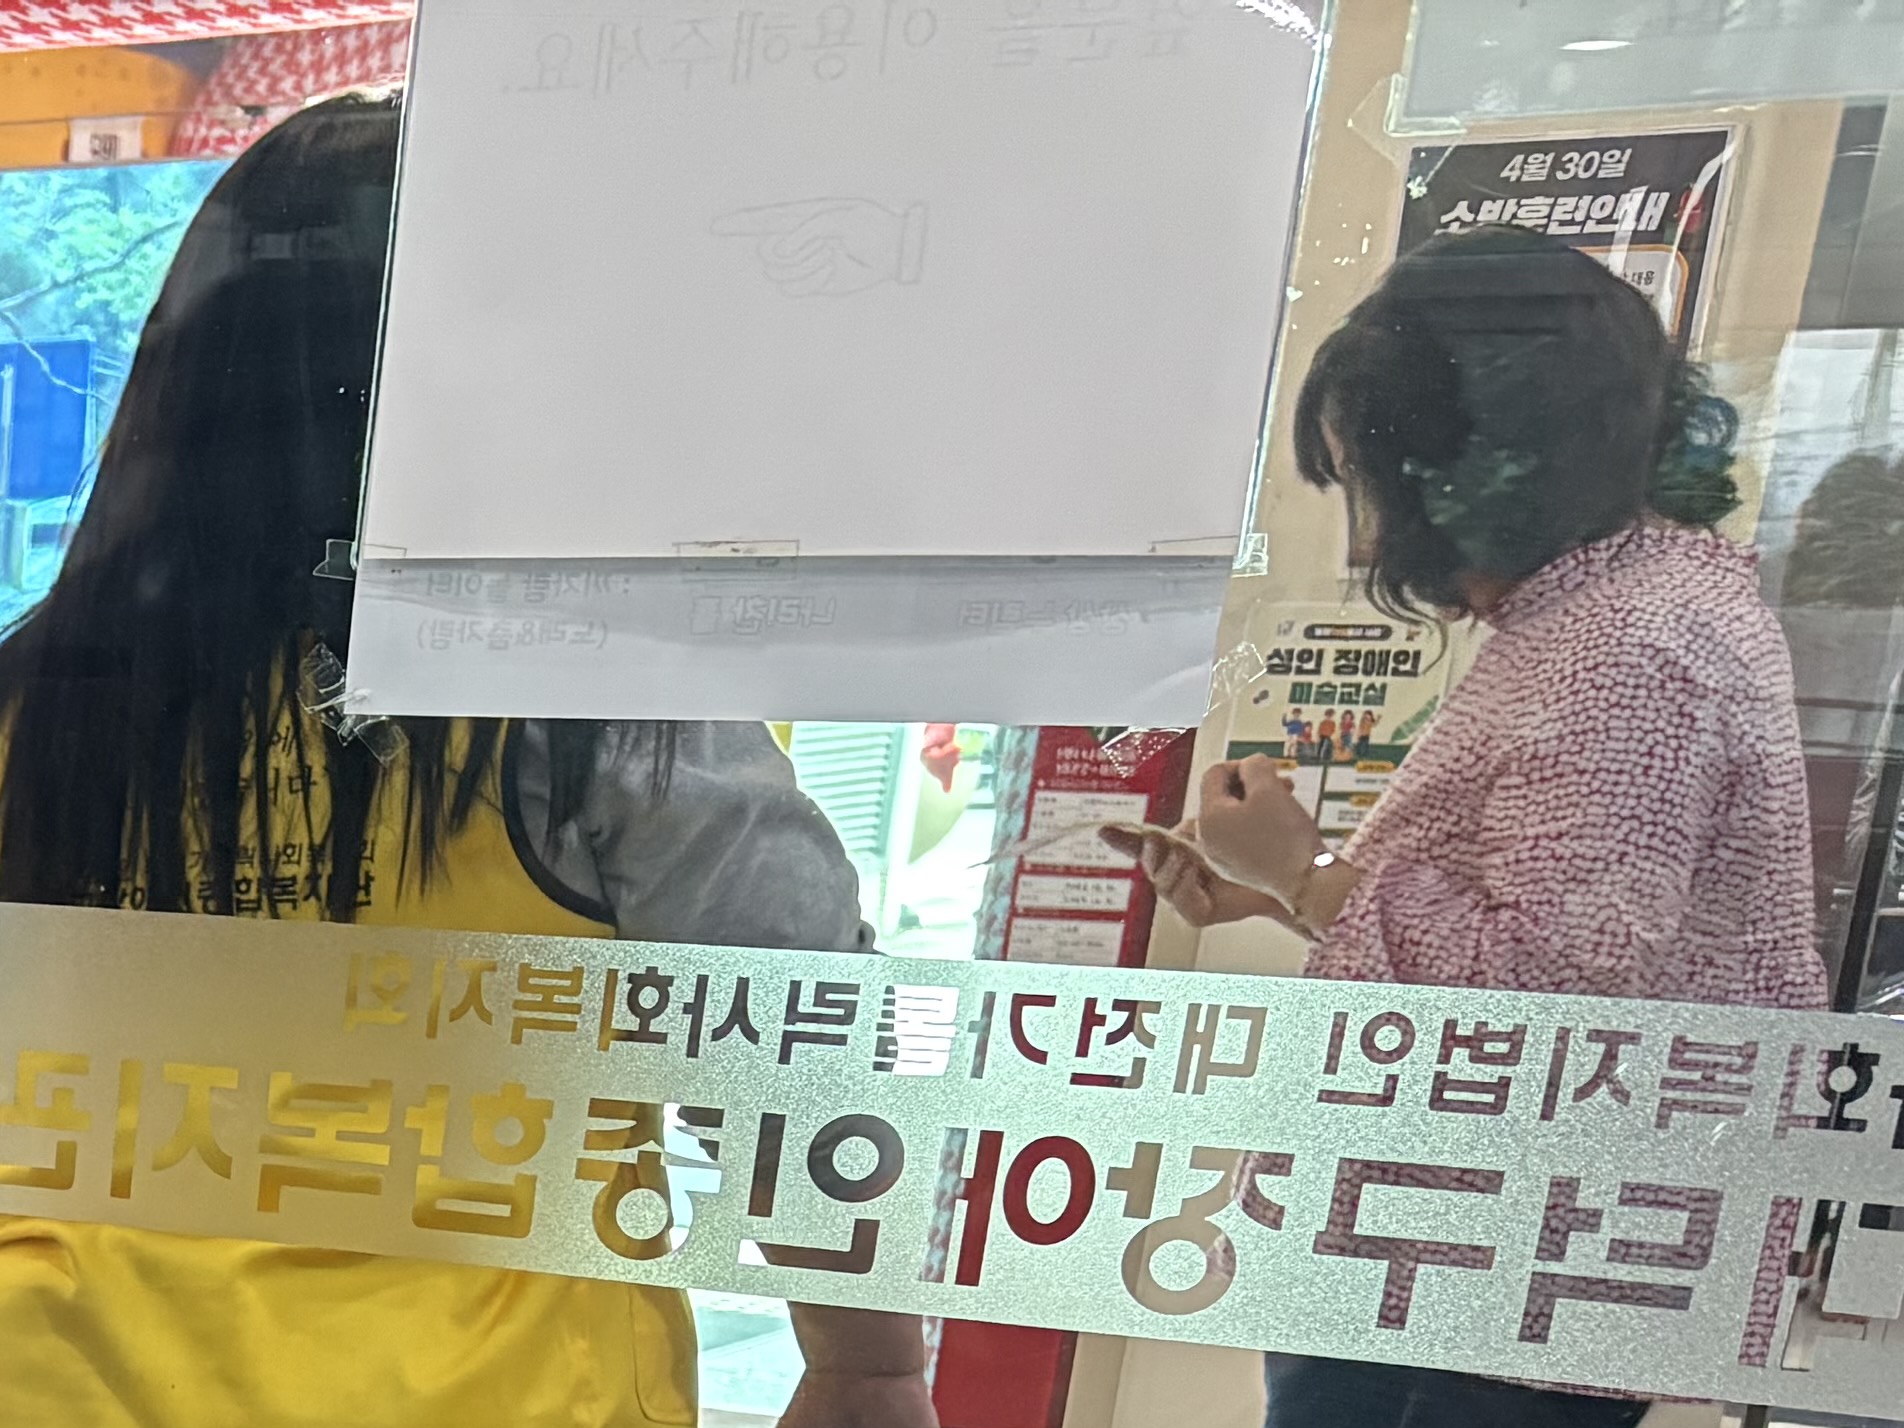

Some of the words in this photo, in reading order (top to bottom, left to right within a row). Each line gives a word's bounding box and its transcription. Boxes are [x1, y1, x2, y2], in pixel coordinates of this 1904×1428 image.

[1499, 151, 1556, 182] 4월
[1556, 148, 1632, 181] 30일
[1267, 647, 1324, 677] 성인
[1332, 648, 1423, 678] 장애인
[1288, 681, 1389, 706] 미술교실
